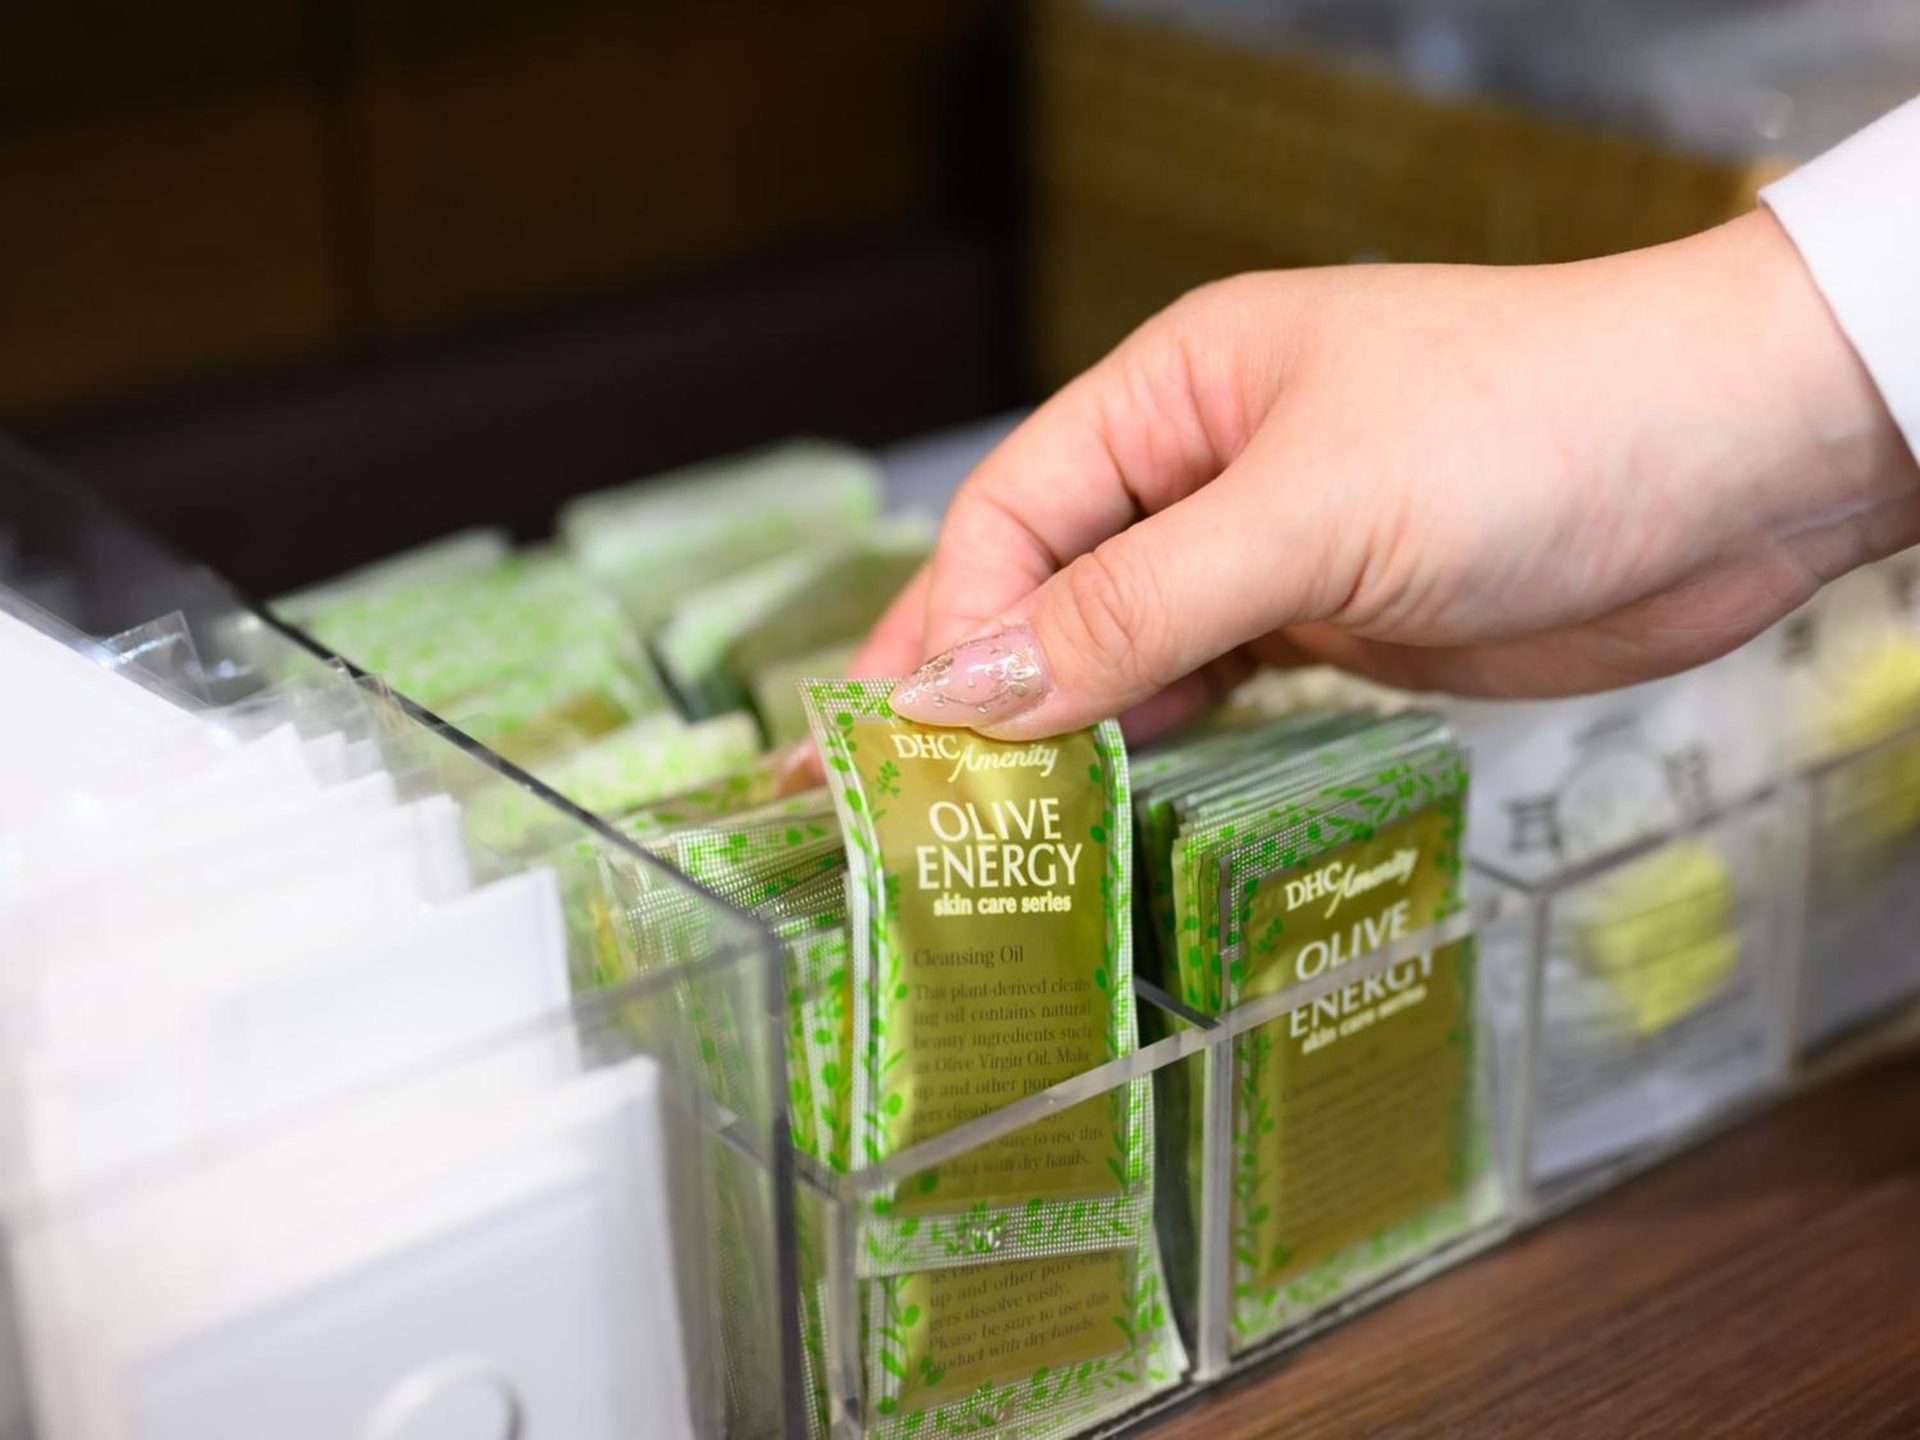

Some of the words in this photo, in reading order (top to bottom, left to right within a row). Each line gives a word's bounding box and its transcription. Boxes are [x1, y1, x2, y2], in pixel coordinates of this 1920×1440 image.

[891, 734, 960, 760] DHC
[948, 745, 1058, 782] Amenity
[929, 798, 1062, 842] OLIVE
[916, 843, 1083, 890] ENERGY
[1284, 861, 1343, 911] DHC
[933, 893, 972, 916] skin
[978, 897, 1016, 914] care
[1021, 891, 1072, 913] series
[1295, 899, 1411, 981] OLIVE
[913, 947, 995, 969] Cleansing
[1000, 945, 1024, 963] Oil
[944, 1005, 964, 1024] oil
[970, 1003, 1036, 1022] contains
[972, 1027, 1056, 1049] ingredients
[934, 1055, 974, 1072] Olive
[978, 1052, 1022, 1072] Virgin
[940, 1078, 969, 1096] and
[974, 1078, 1015, 1096] other
[957, 1279, 988, 1301] and
[993, 1269, 1035, 1291] other
[964, 1296, 1024, 1321] dissolve
[982, 1322, 1001, 1339] be
[1003, 1314, 1037, 1332] sure
[1041, 1309, 1054, 1322] to
[988, 1337, 1021, 1358] with
